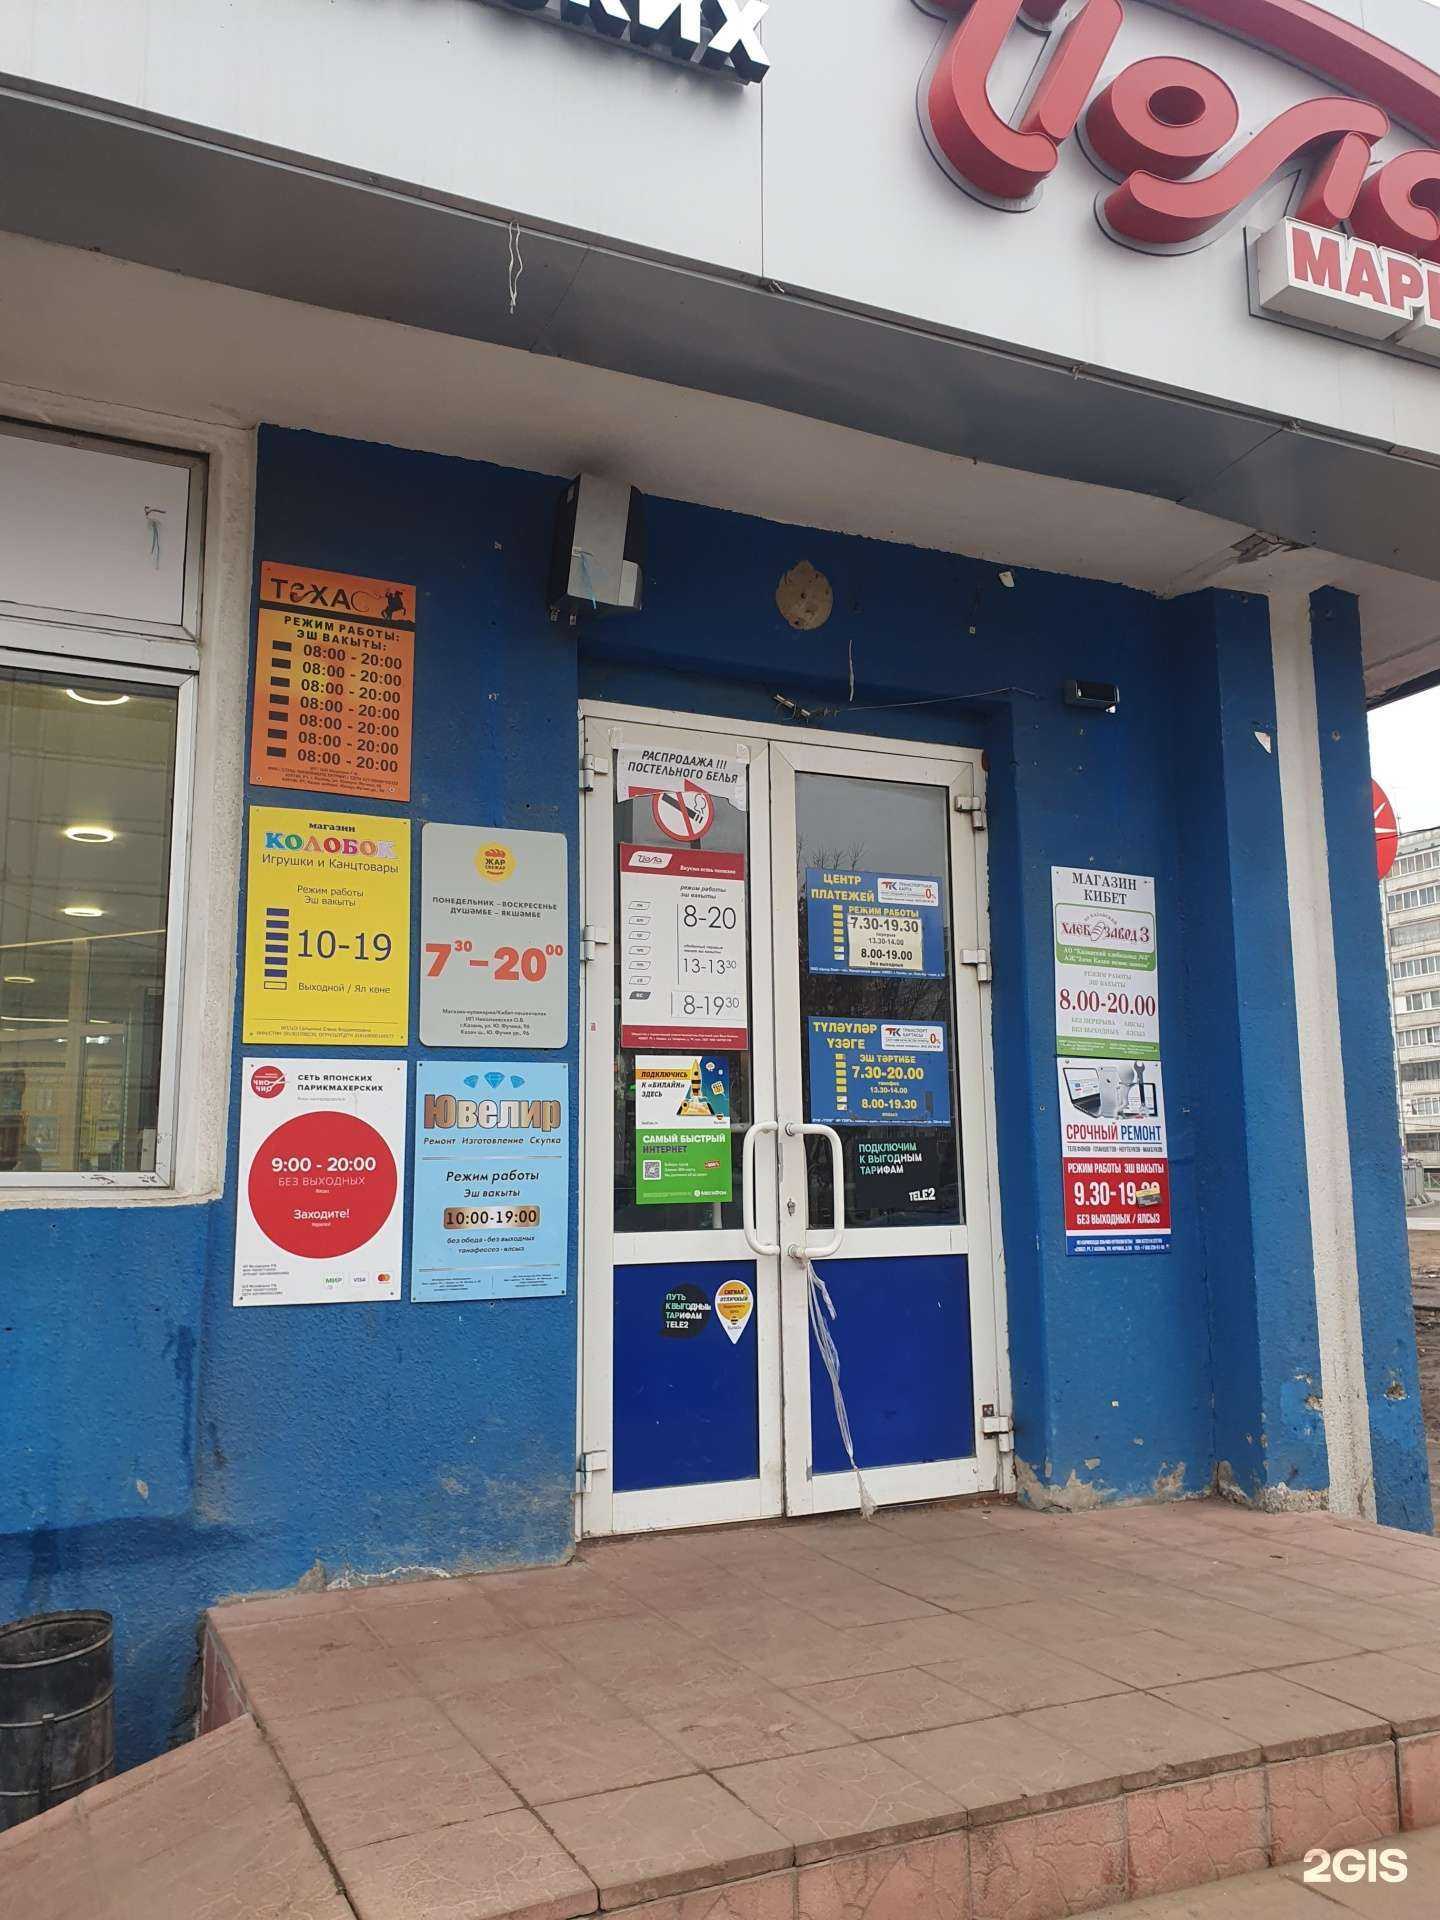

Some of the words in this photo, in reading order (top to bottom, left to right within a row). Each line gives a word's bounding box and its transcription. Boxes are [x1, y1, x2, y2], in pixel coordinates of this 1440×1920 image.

[1290, 226, 1440, 321] МАР
[284, 616, 334, 632] РЕЖИМ
[339, 624, 400, 641] РАБОТЫ:
[297, 629, 319, 641] ЭШ
[322, 633, 387, 651] ВАКЫТЫ:
[303, 644, 345, 662] 08:00
[360, 653, 402, 669] 20:00
[302, 662, 345, 678] 08:00
[360, 670, 401, 687] 20:00
[301, 679, 344, 696] 08:00
[359, 687, 400, 704] 20:00
[300, 696, 343, 713] 08:00
[358, 705, 400, 721] 20:00
[299, 714, 342, 730] 08:00
[357, 722, 399, 738] 20:00
[298, 731, 341, 748] 08:00
[357, 739, 399, 756] 20:00
[297, 749, 341, 765] 08:00
[356, 757, 398, 773] 20:00
[642, 750, 713, 768] РАСПРОДАЖА
[716, 760, 727, 770] !!!
[628, 762, 703, 779] ПОСТЕЛЬНОГО
[706, 771, 738, 784] БЕЛЬЯ
[265, 832, 398, 859] КОЛОБОК
[262, 854, 314, 868] Игрушки
[329, 859, 399, 874] Канцтовары
[485, 857, 506, 866] ЖАР
[823, 874, 862, 885] ЦЕНТР
[1072, 872, 1137, 891] МАГАЗИН
[297, 885, 328, 896] Режим
[331, 887, 364, 898] работы
[811, 889, 874, 902] ПЛАТЕЖЕЙ
[1084, 889, 1127, 905] КИБЕТ
[304, 895, 318, 905] Эш
[322, 897, 356, 906] вакыты
[433, 897, 494, 907] ПОНЕДЕЛЬНИК
[502, 901, 557, 910] ВОСКРЕСЕНЬЕ
[684, 905, 736, 929] 8-20
[849, 906, 881, 916] РЕЖИМ
[884, 908, 919, 918] РАБОТЫ
[850, 917, 919, 933] 7.30-19.30
[1140, 927, 1150, 942] 3
[298, 929, 392, 961] 10-19
[861, 948, 913, 960] 8.00-19.00
[298, 982, 345, 993] Выходной
[354, 984, 366, 993] Ял
[1059, 988, 1156, 1017] 8.00-20.00
[859, 1054, 875, 1062] ЭШ
[877, 1055, 917, 1063] ТӘРТИБЕ
[298, 1074, 321, 1082] СЕТЬ
[852, 1066, 924, 1079] 7.30-20.00
[297, 1084, 384, 1092] ПАРИКМАХЕРСКИХ
[861, 1099, 917, 1109] 8.00-19.30
[423, 1093, 561, 1133] Ювелир
[643, 1134, 679, 1143] САМЫЙ
[680, 1133, 726, 1143] БЫСТРЫЙ
[1067, 1122, 1118, 1140] СРОЧНЫЙ
[1121, 1125, 1161, 1141] РЕМОНТ
[424, 1137, 456, 1145] Ремонт
[462, 1137, 524, 1145] Изготовление
[529, 1136, 561, 1145] Скупка
[643, 1145, 688, 1154] ИНТЕРНЕТ
[859, 1142, 917, 1153] ПОДКЛЮЧИМ
[272, 1157, 311, 1173] 9:00
[327, 1157, 376, 1172] 20:00
[860, 1155, 866, 1164] К
[868, 1153, 922, 1164] ВЫГОДНЫМ
[860, 1165, 904, 1175] ТАРИФАМ
[1068, 1163, 1093, 1174] РЕЖИМ
[1095, 1163, 1121, 1174] РАБОТЫ
[1124, 1163, 1135, 1174] ЭШ
[1135, 1163, 1164, 1174] ВАКЫТЫ
[279, 1178, 299, 1186] БЕЗ
[302, 1177, 365, 1187] ВЫХОДНЫХ
[446, 1171, 489, 1182] Режим
[492, 1170, 539, 1184] работы
[464, 1189, 480, 1198] Эш
[483, 1189, 521, 1198] вакыты
[909, 1188, 936, 1201] TELE2
[294, 1209, 350, 1220] Заходите!
[447, 1210, 537, 1225] 10:00-19:00
[1077, 1214, 1090, 1224] БЕЗ
[1091, 1214, 1131, 1226] ВЫХОДНЫХ
[1137, 1213, 1160, 1224] ЯЛСЫЗ
[666, 1293, 687, 1301] ПУТЬ
[666, 1312, 702, 1320] ТАРИФАМ
